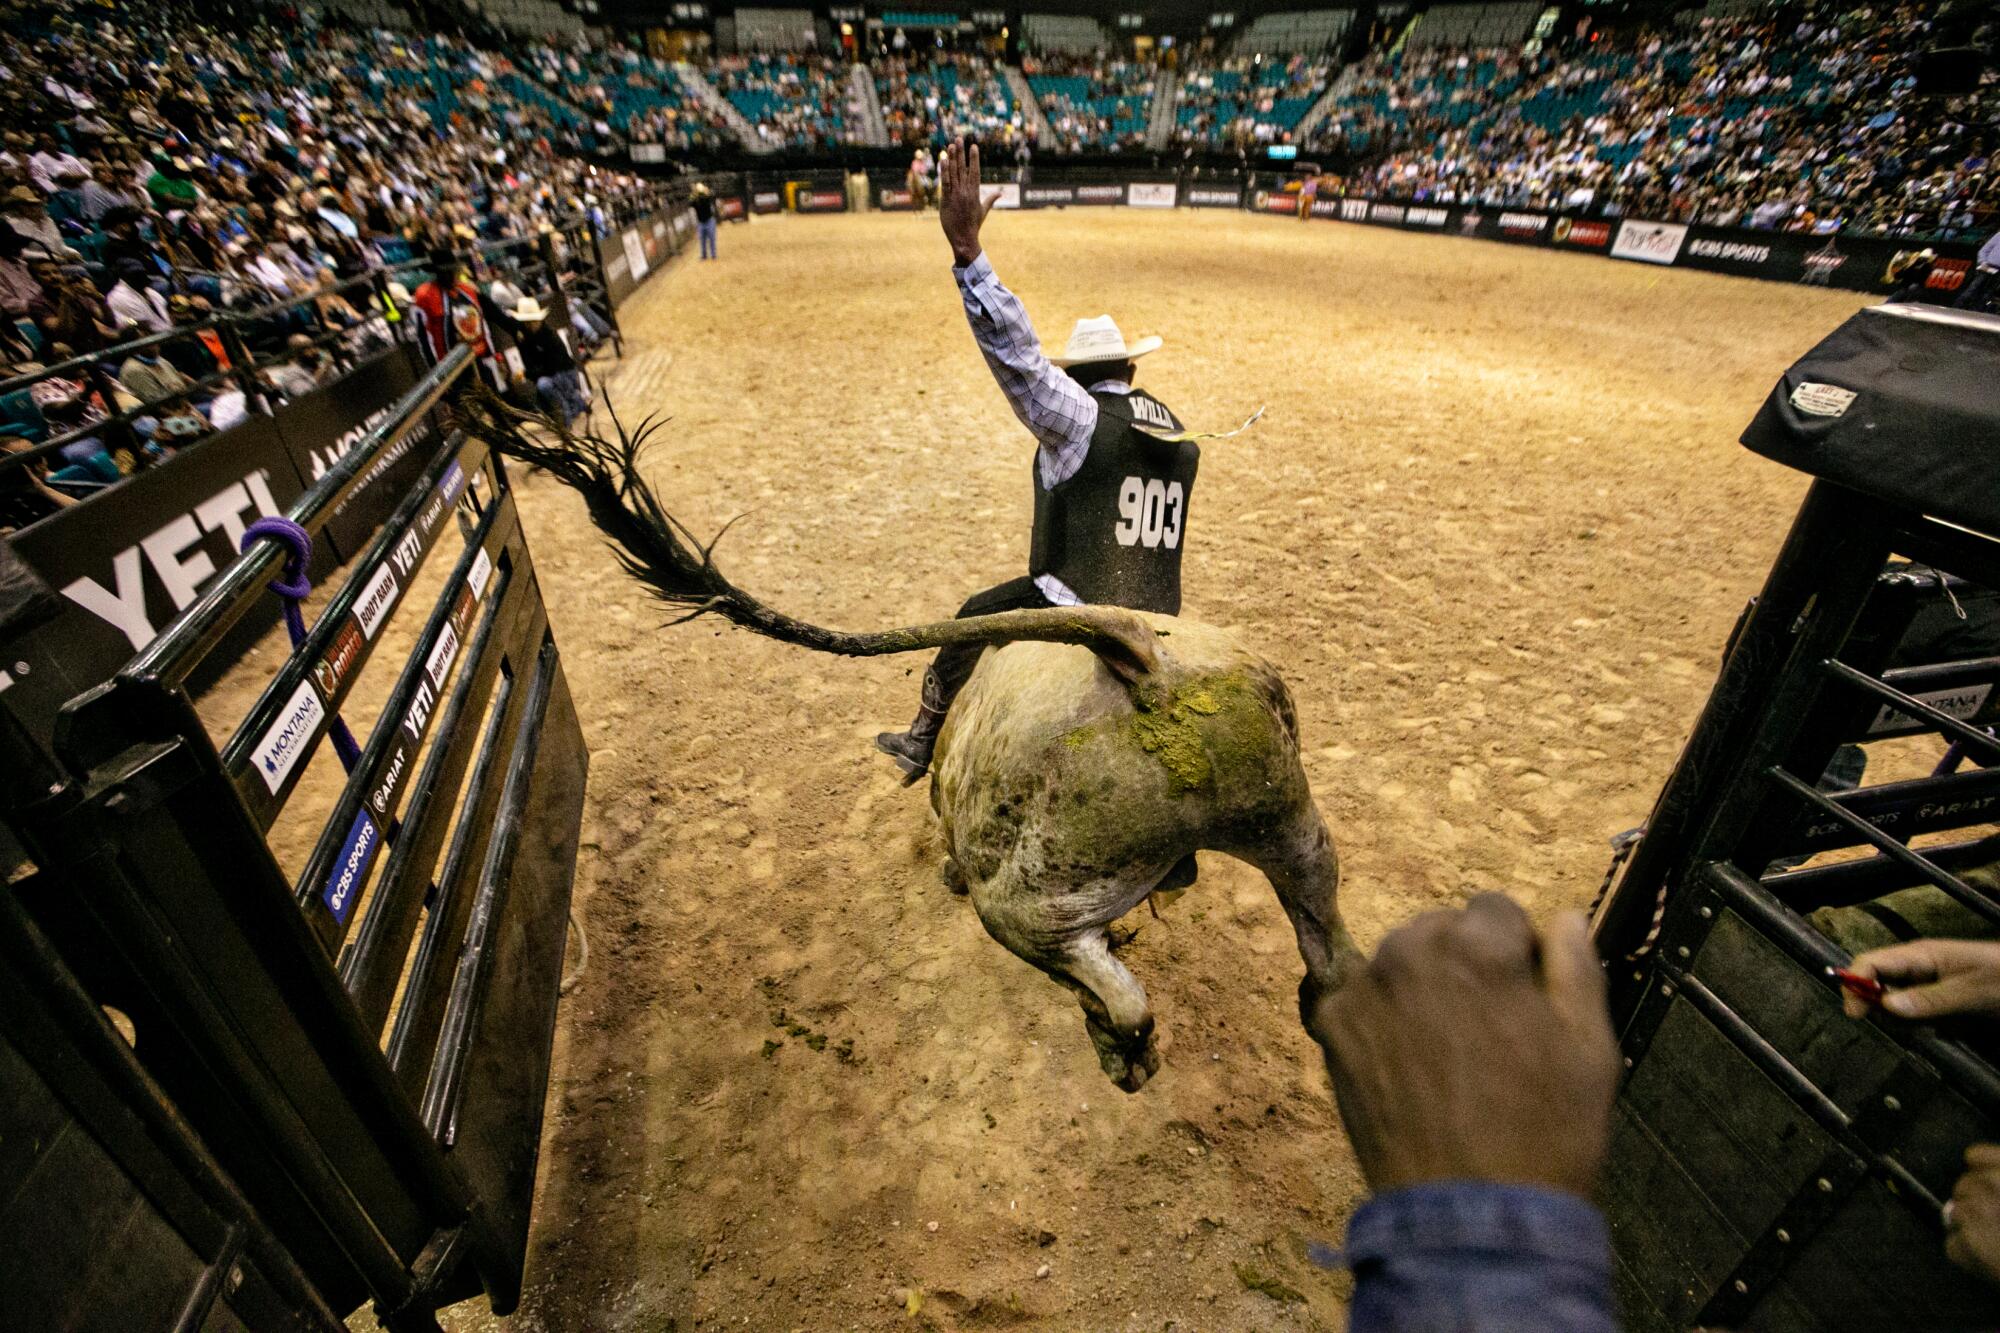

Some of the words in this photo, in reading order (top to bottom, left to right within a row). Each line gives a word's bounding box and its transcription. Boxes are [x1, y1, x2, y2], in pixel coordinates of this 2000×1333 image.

[1341, 199, 1369, 220] YETI
[1699, 239, 1722, 258] CBS
[1721, 241, 1771, 264] SPORTS
[1115, 475, 1184, 550] 903
[391, 528, 422, 577] YETI
[359, 594, 378, 627] BOOT
[375, 573, 395, 602] BARN
[271, 696, 315, 761] MONTANA
[404, 680, 434, 740] YETI
[381, 747, 406, 801] ARIAT
[1931, 796, 1996, 818] ARIAT
[336, 867, 354, 899] CBS
[347, 821, 375, 875] SPORTS
